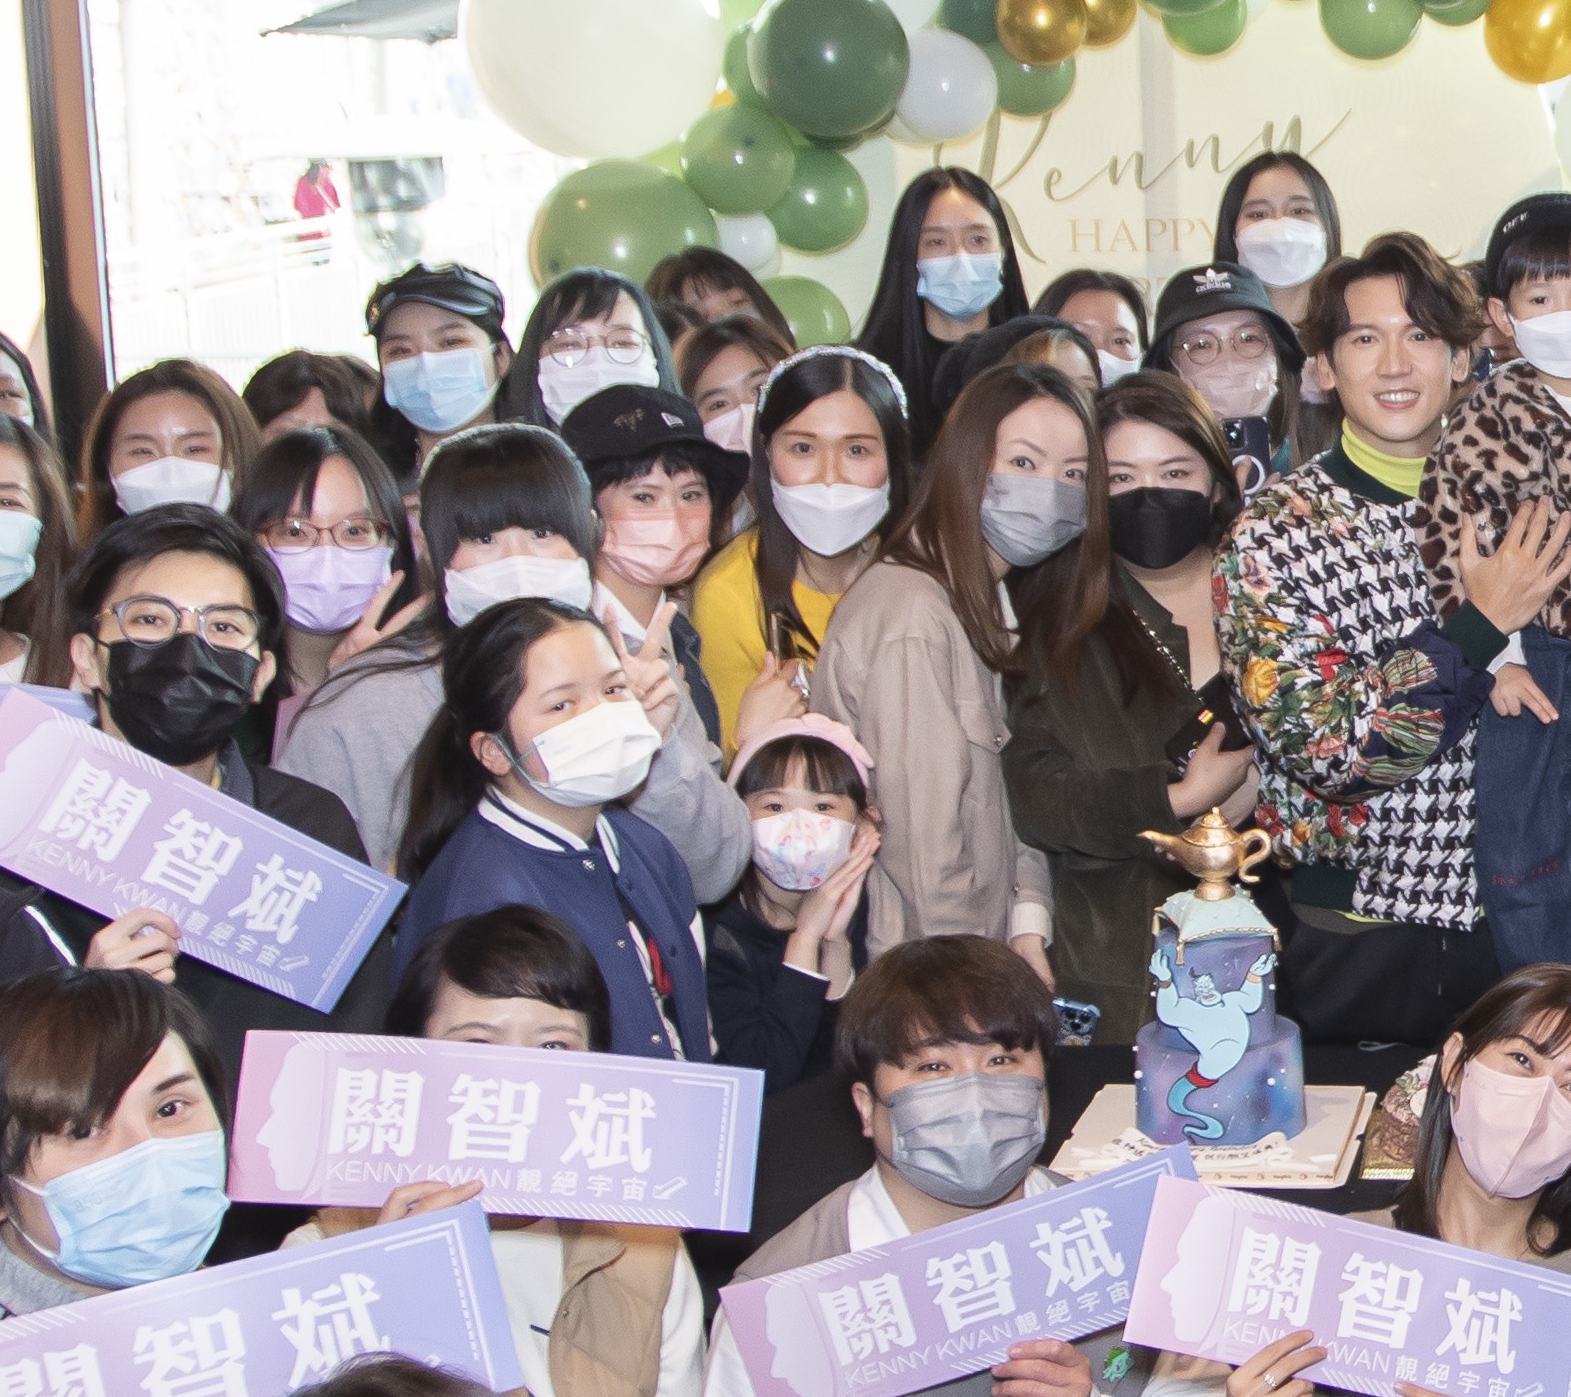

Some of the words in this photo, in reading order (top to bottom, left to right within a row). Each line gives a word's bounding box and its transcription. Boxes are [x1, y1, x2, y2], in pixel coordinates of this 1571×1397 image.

[1069, 218, 1217, 253] HAPPY
[27, 837, 115, 888] KENNY
[116, 880, 186, 927] KWAN
[37, 758, 324, 944] 關智斌
[329, 1068, 658, 1175] 關智斌
[325, 1160, 426, 1185] KENNY
[426, 1163, 512, 1189] KWAN
[816, 1206, 1127, 1367] 關智斌
[1227, 1226, 1524, 1375] 關智斌
[843, 1346, 930, 1388] KENNY
[934, 1321, 1014, 1362] KWAN
[1223, 1319, 1307, 1352] KENN
